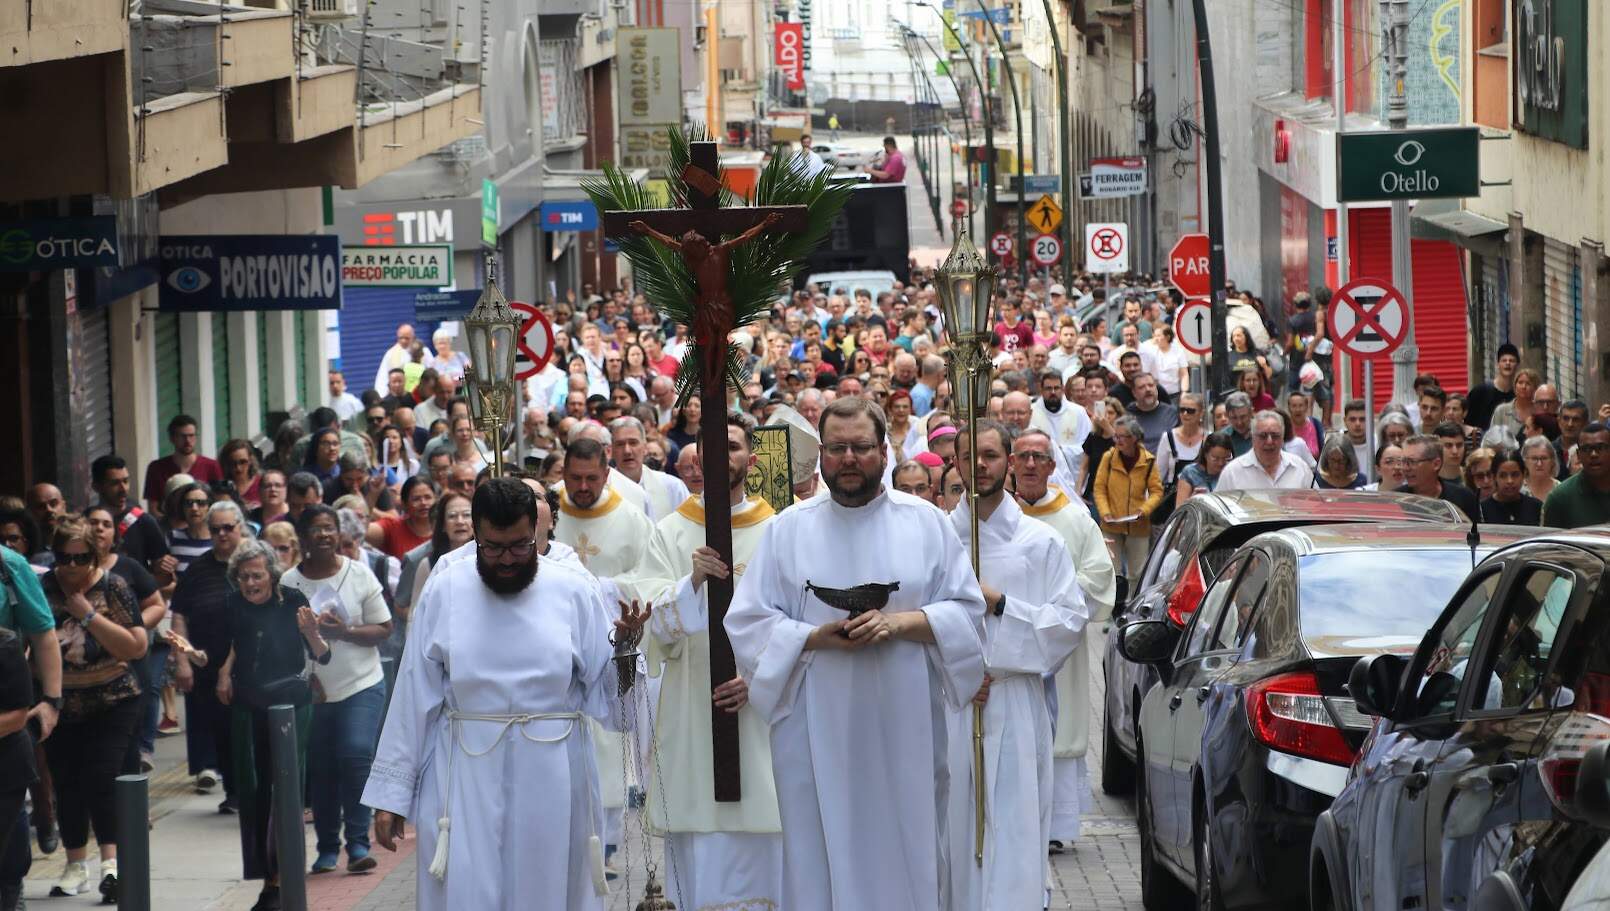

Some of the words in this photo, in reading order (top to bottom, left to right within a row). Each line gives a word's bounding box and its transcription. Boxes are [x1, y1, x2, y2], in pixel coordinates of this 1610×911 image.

[780, 30, 799, 82] ALDO
[1095, 173, 1142, 184] FERRAGEM
[1381, 169, 1439, 193] Otello
[397, 208, 454, 244] TIM
[561, 212, 583, 223] TIM
[36, 236, 115, 258] ÓTICA
[1037, 241, 1057, 255] 20
[342, 250, 439, 265] FARMÁCIA
[1173, 256, 1210, 276] PAR
